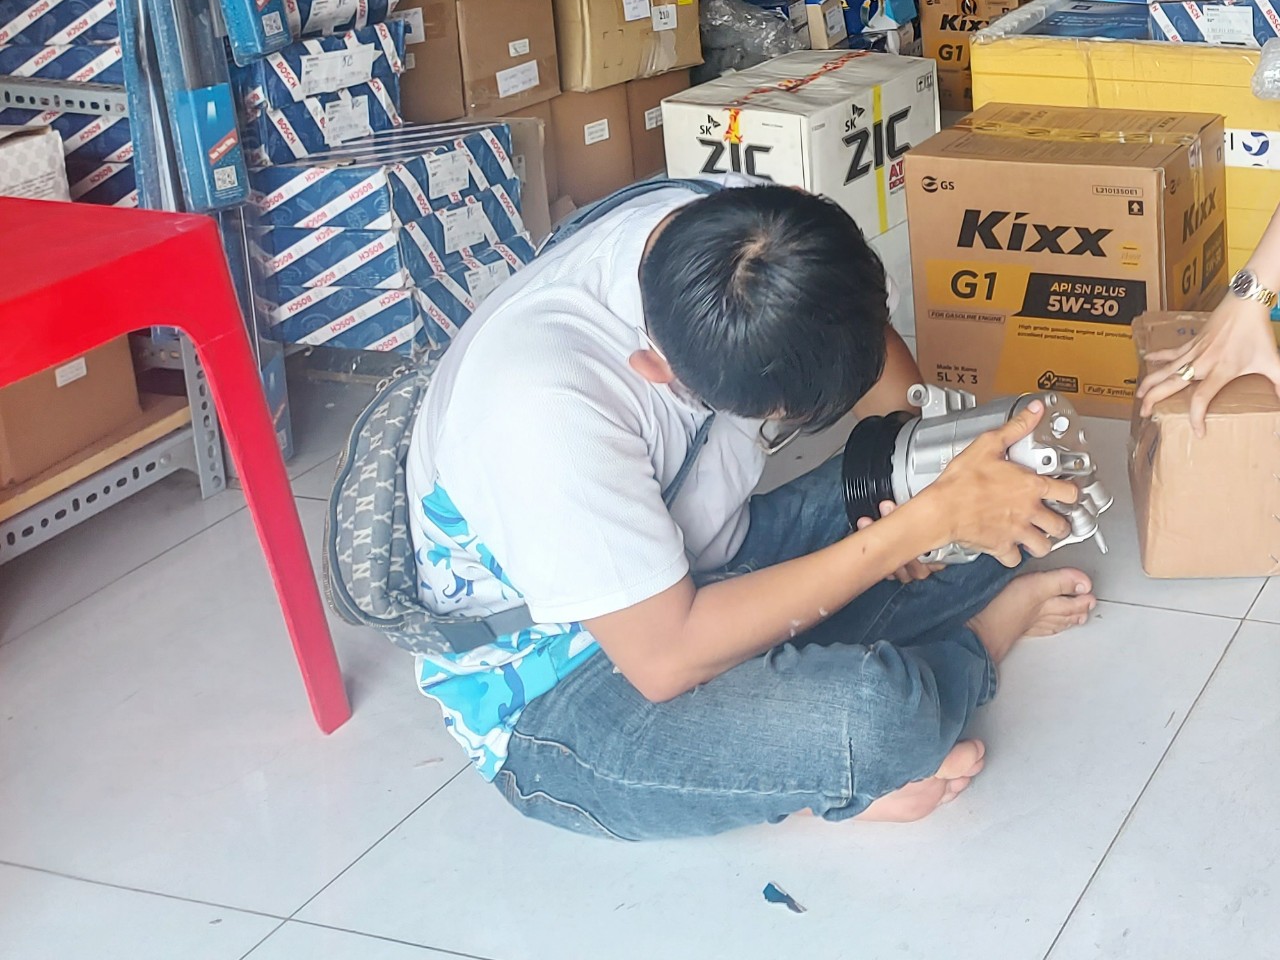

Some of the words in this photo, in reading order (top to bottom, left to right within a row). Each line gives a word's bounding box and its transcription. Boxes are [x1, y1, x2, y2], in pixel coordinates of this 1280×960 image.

[28, 1, 50, 21] BOSCH
[66, 18, 89, 38] BOSCH
[34, 48, 57, 68] BOSCH
[938, 44, 963, 62] G1
[276, 61, 298, 89] BOSCH
[80, 123, 101, 141] BOSCH
[277, 117, 296, 144] BOSCH
[700, 125, 712, 136] SK
[845, 119, 857, 133] SK
[490, 137, 506, 162] BOSCH
[842, 105, 912, 186] ZIC
[696, 137, 773, 180] ZIC
[348, 182, 374, 201] BOSCH
[940, 181, 955, 191] GS
[500, 193, 515, 217] BOSCH
[1182, 188, 1217, 244] Kixx
[957, 209, 1114, 258] Kixx
[359, 242, 384, 261] BOSCH
[950, 270, 998, 301] G1
[1182, 258, 1198, 296] G1
[1050, 282, 1072, 293] API
[1075, 284, 1091, 294] SN
[1094, 285, 1126, 298] PLUS
[287, 295, 312, 313] BOSCH
[1047, 296, 1119, 316] 5W-30
[330, 316, 356, 333] BOSCH
[428, 305, 450, 330] BOSCH
[947, 313, 977, 321] GASOLINE
[978, 315, 1002, 323] ENGINE
[1044, 333, 1074, 341] protection
[1051, 327, 1075, 335] gasoline
[937, 372, 952, 383] 5L
[957, 373, 965, 384] X
[971, 374, 978, 385] 3
[1088, 386, 1104, 395] Fully
